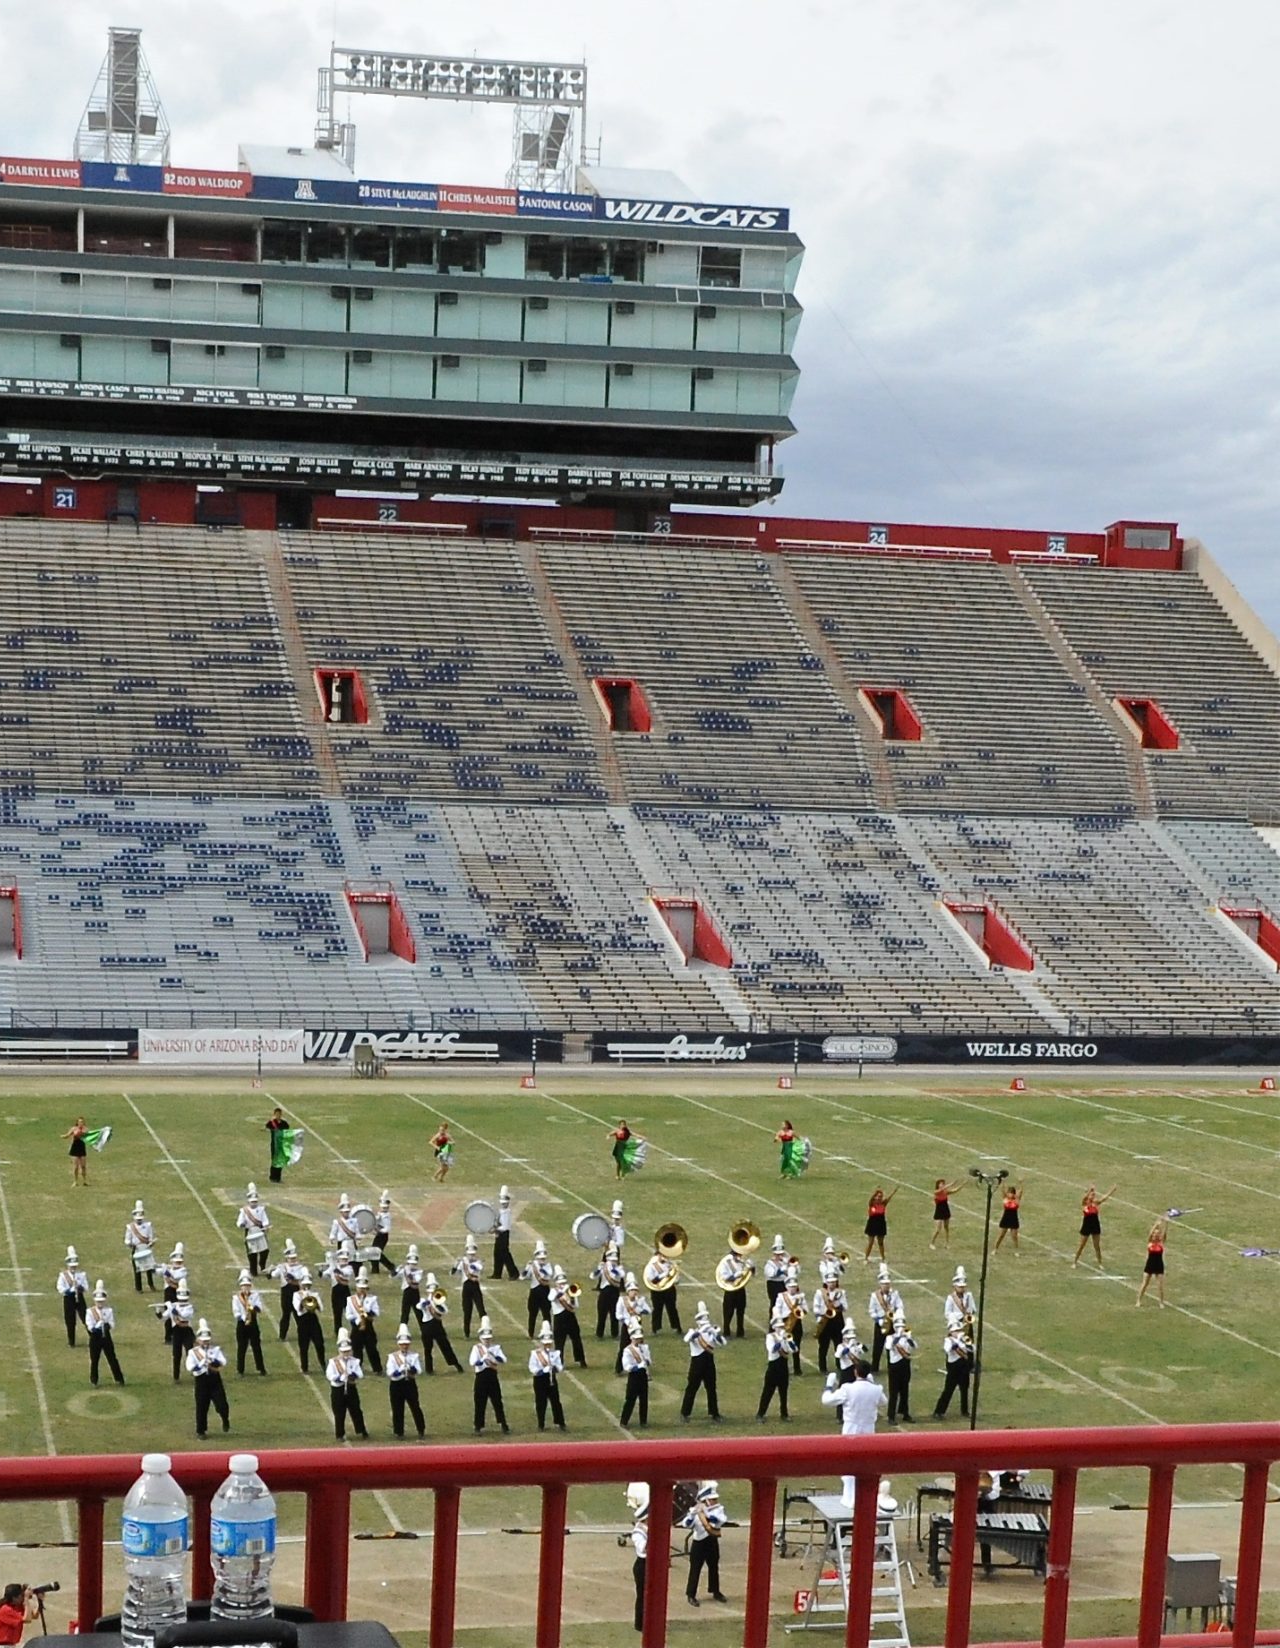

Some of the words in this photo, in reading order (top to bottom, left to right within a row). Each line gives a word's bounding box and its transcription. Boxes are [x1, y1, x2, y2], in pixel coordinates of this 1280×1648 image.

[0, 164, 6, 174] 4
[8, 165, 48, 177] DARRYLL
[52, 168, 79, 179] LEWIS
[165, 173, 176, 185] 92
[177, 175, 195, 186] ROB
[198, 176, 242, 189] WALDROP
[371, 187, 390, 199] STEVE
[393, 189, 437, 202] McLAUGHLIN
[440, 190, 446, 202] 11
[448, 192, 471, 203] CHRIS
[474, 194, 516, 206] McALISTER
[526, 197, 561, 210] ANTOINE
[564, 200, 592, 212] CASON
[606, 201, 778, 230] WILDCATS
[266, 393, 296, 401] THOMAS
[32, 445, 60, 453] LUPPINO
[93, 447, 121, 456] WALLACE
[126, 449, 144, 457] CHRIS
[146, 450, 178, 459] McALISTER
[299, 457, 315, 465] JOSH
[317, 458, 338, 466] MILLER
[353, 460, 375, 468] CHUCK
[377, 461, 393, 469] CECIL
[404, 462, 421, 470] MARK
[594, 470, 612, 478] LEWIS
[743, 477, 772, 485] WALDROP
[57, 494, 73, 507] 21
[379, 509, 397, 521] 22
[654, 522, 671, 534] 23
[870, 532, 886, 544] 24
[1049, 542, 1065, 554] 25
[143, 1039, 193, 1053] UNIVERSITY
[195, 1039, 207, 1053] OF
[210, 1039, 250, 1053] ARIZONA
[253, 1039, 278, 1053] BAND
[281, 1039, 299, 1053] DAY
[966, 1043, 1032, 1057] WELLS
[1035, 1043, 1098, 1057] FARGO
